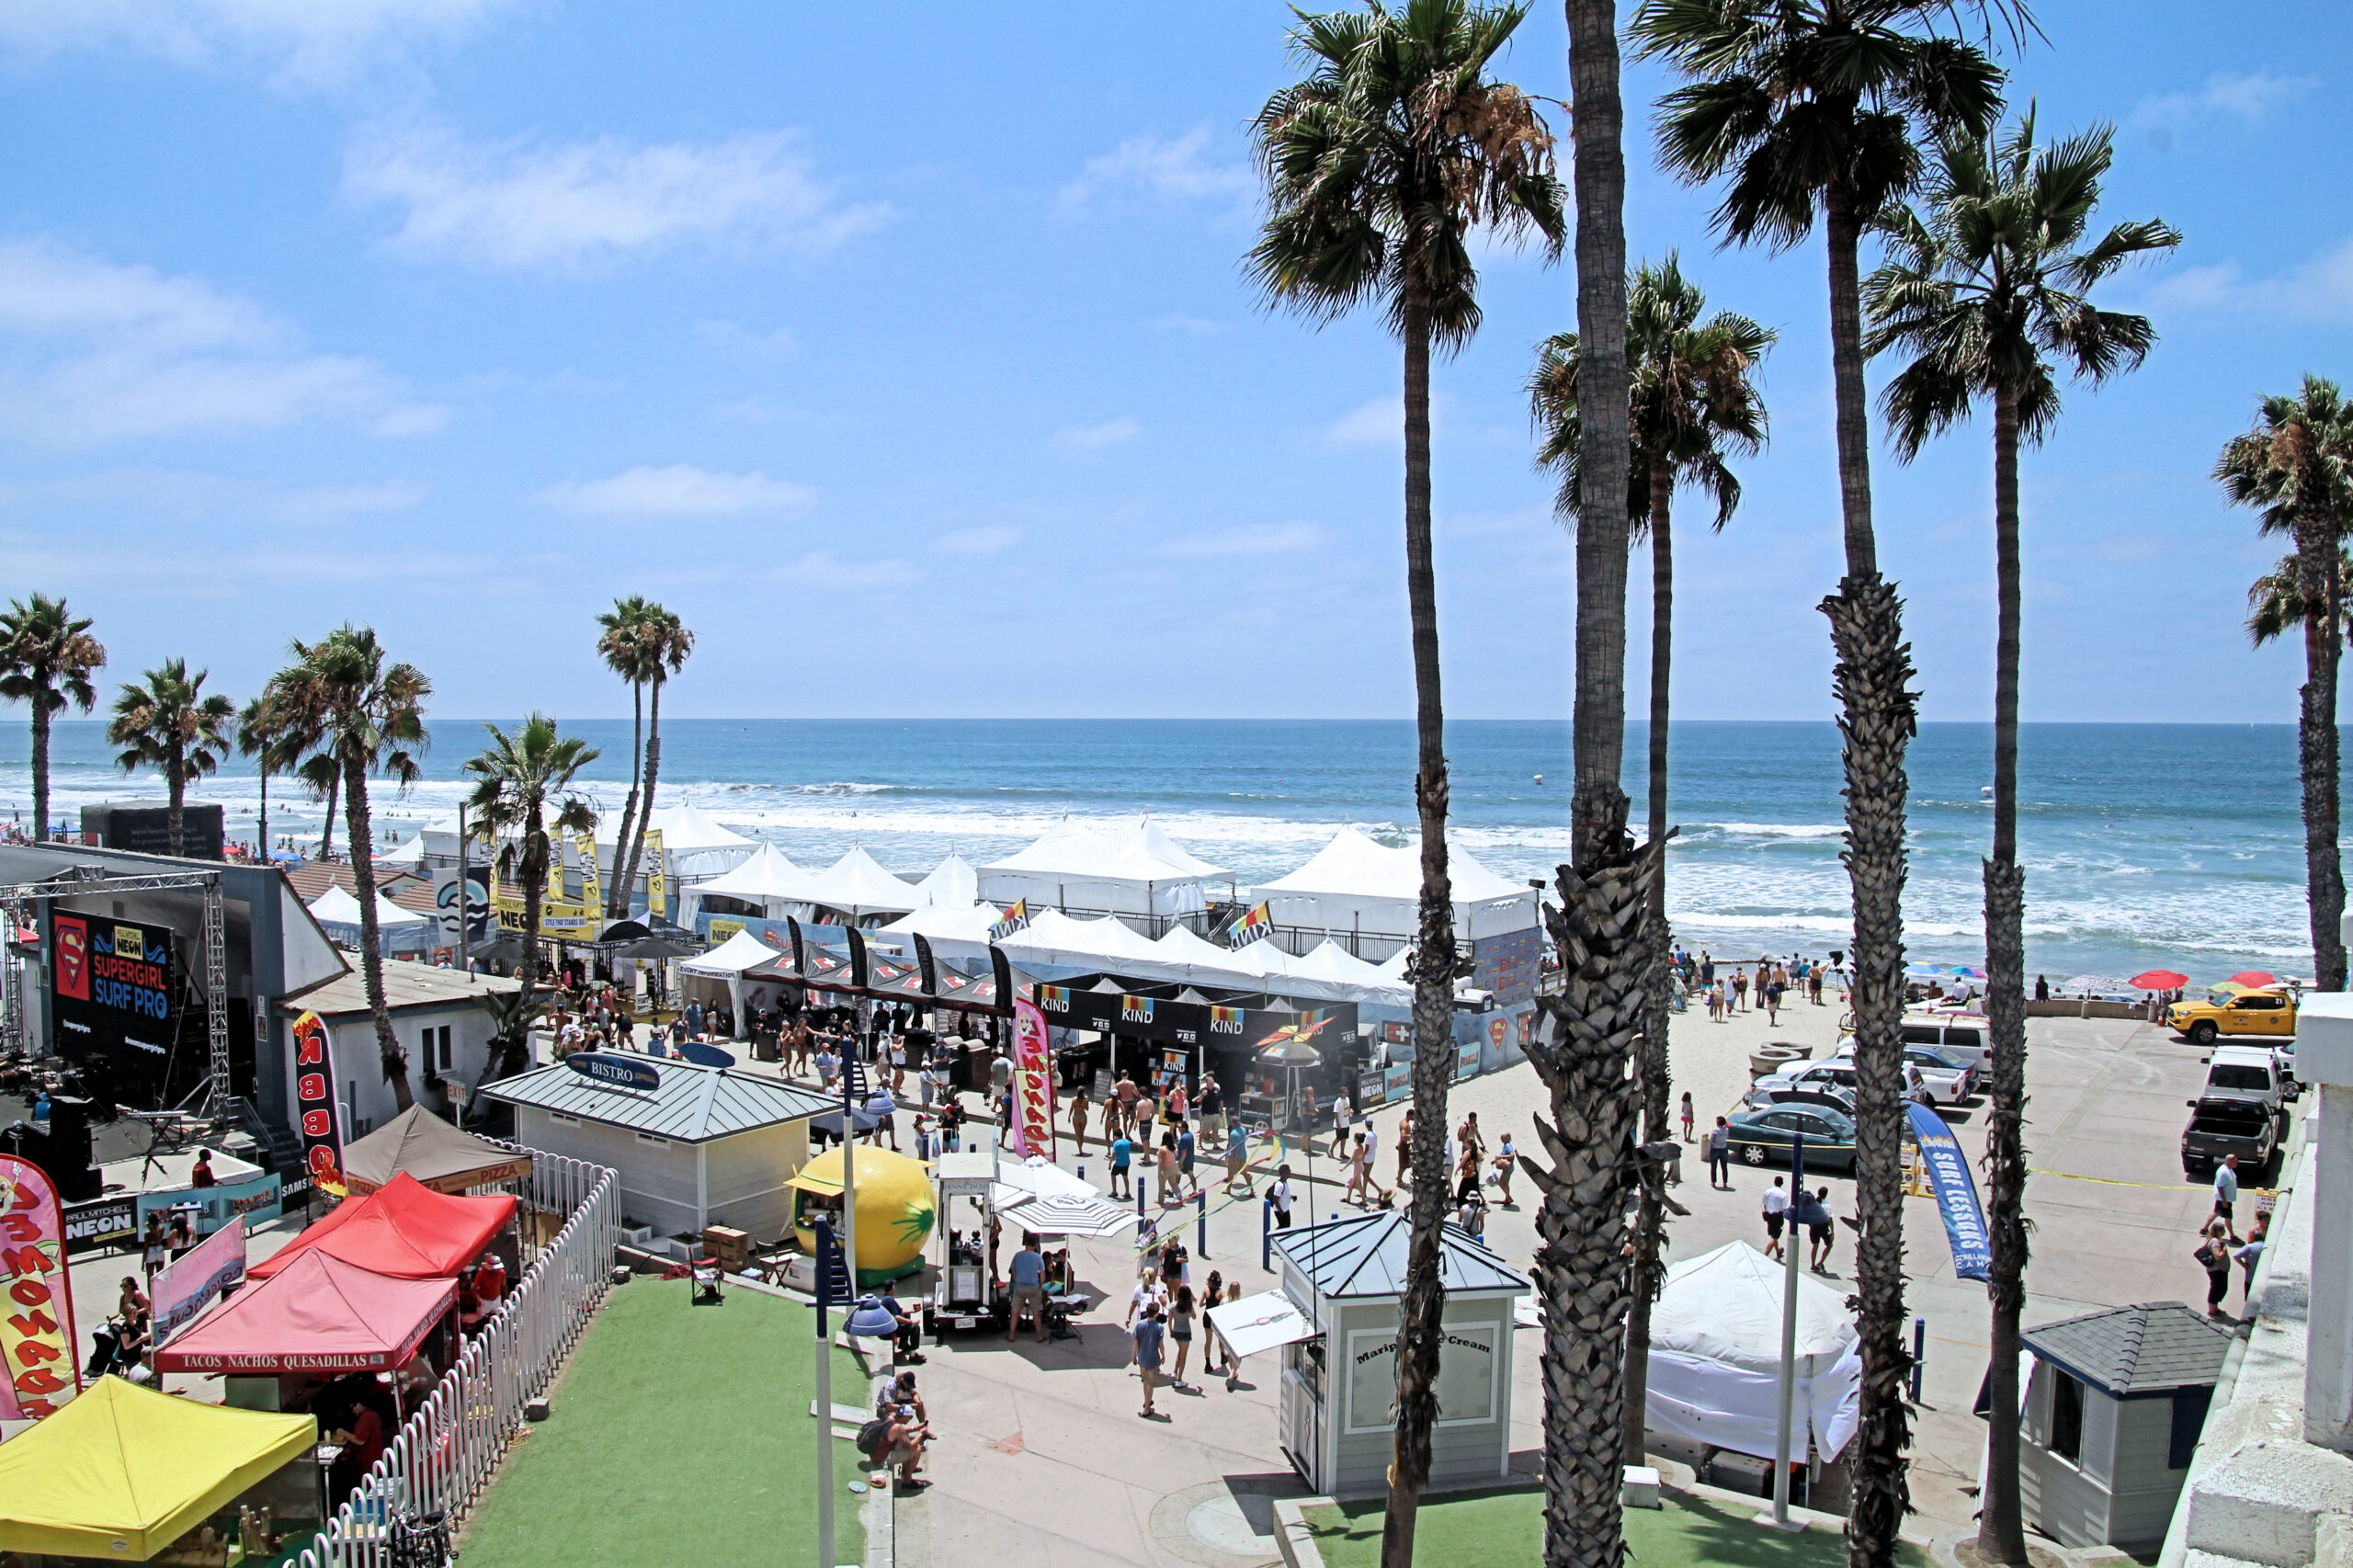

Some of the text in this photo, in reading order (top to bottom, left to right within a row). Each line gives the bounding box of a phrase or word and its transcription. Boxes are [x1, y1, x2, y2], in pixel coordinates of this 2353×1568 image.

[117, 938, 142, 956] NEON
[94, 954, 166, 991] SUPERGIRL
[680, 966, 697, 974] EVENT
[95, 978, 167, 1020] SURF PRO
[1040, 998, 1070, 1013] KIND
[1121, 1008, 1154, 1024] KIND
[1210, 1019, 1245, 1035] KIND
[591, 1062, 633, 1083] BISTRO
[1164, 1061, 1186, 1073] KIND
[448, 1084, 465, 1100] EXIT
[1360, 1083, 1383, 1098] NEON
[480, 1164, 518, 1183] PIZZA
[1933, 1152, 1965, 1187] SURF
[66, 1205, 131, 1223] PAUL MITCHELL
[1946, 1189, 1984, 1250] LESSONS
[65, 1213, 132, 1241] NEON
[1448, 1335, 1491, 1354] Cream
[183, 1355, 222, 1368] TACOS
[228, 1354, 278, 1368] NACHOS
[283, 1354, 368, 1369] QUESADILLAS
